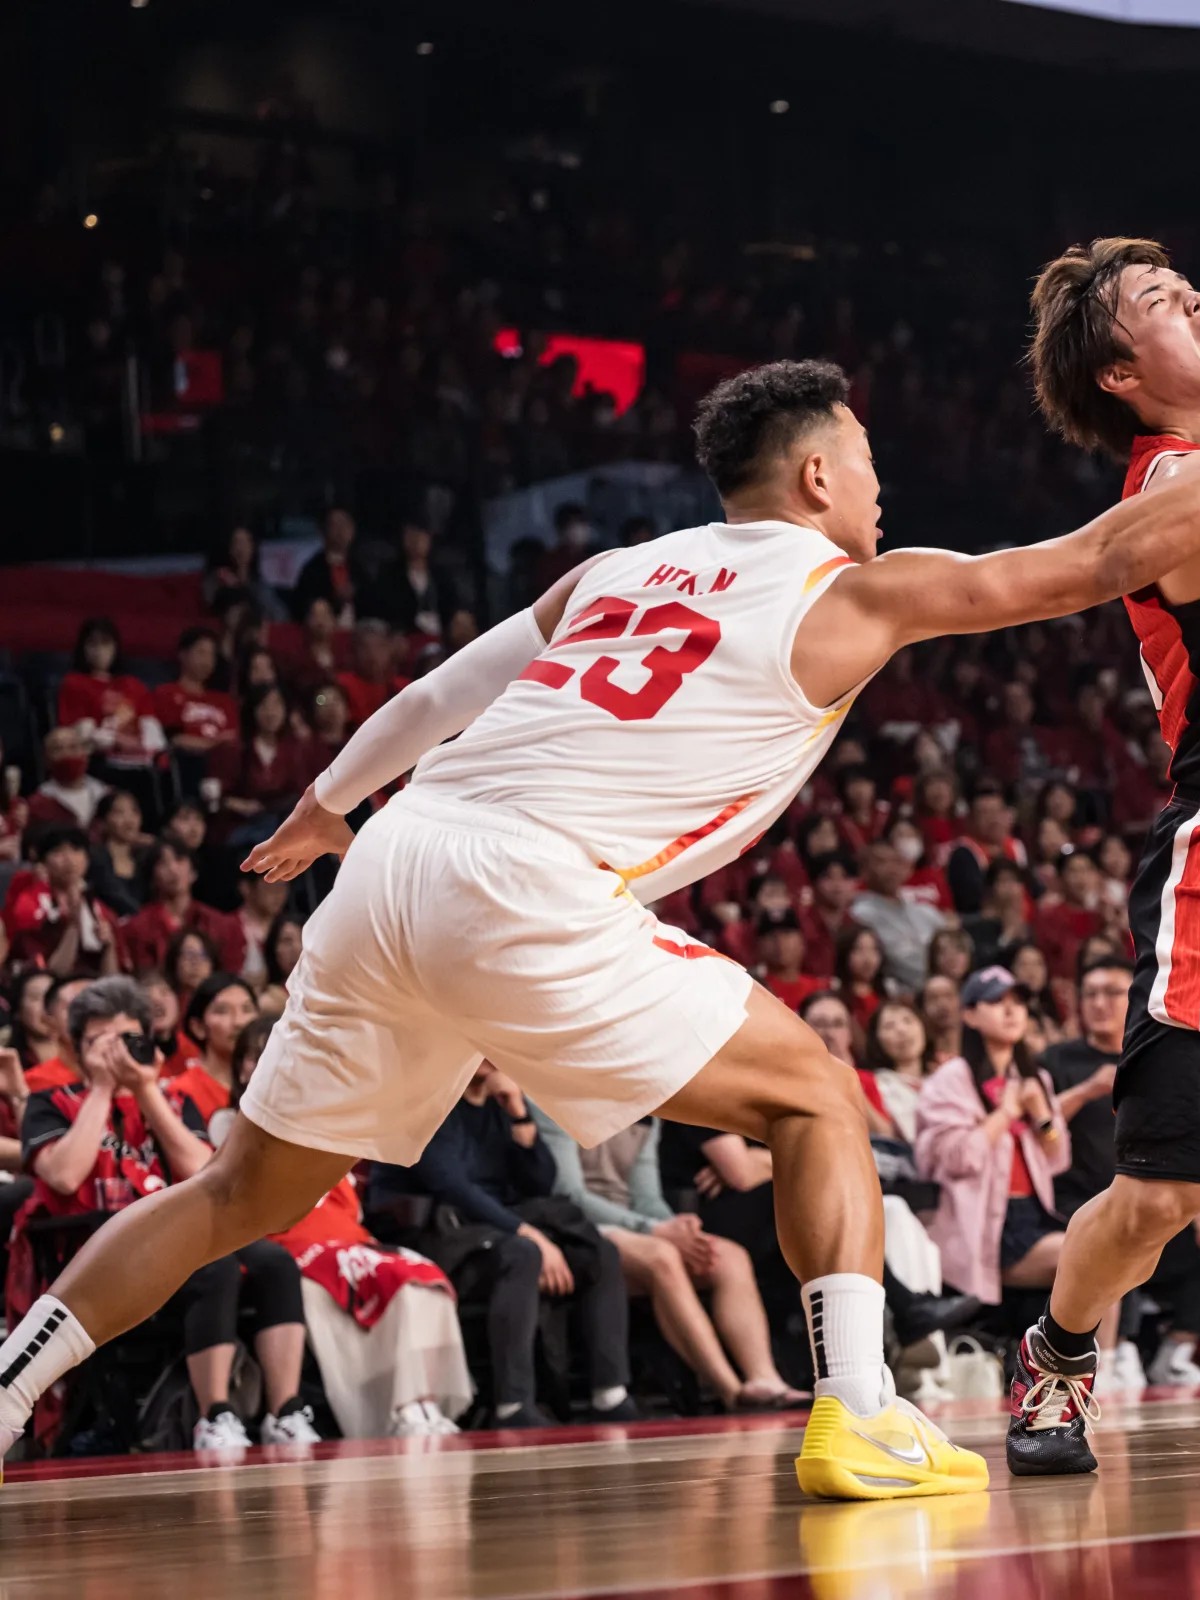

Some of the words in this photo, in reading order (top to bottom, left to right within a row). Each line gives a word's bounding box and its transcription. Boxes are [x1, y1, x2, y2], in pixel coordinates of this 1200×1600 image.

[516, 596, 722, 722] 23
[1035, 1346, 1059, 1371] balance
[1043, 1349, 1057, 1362] new
